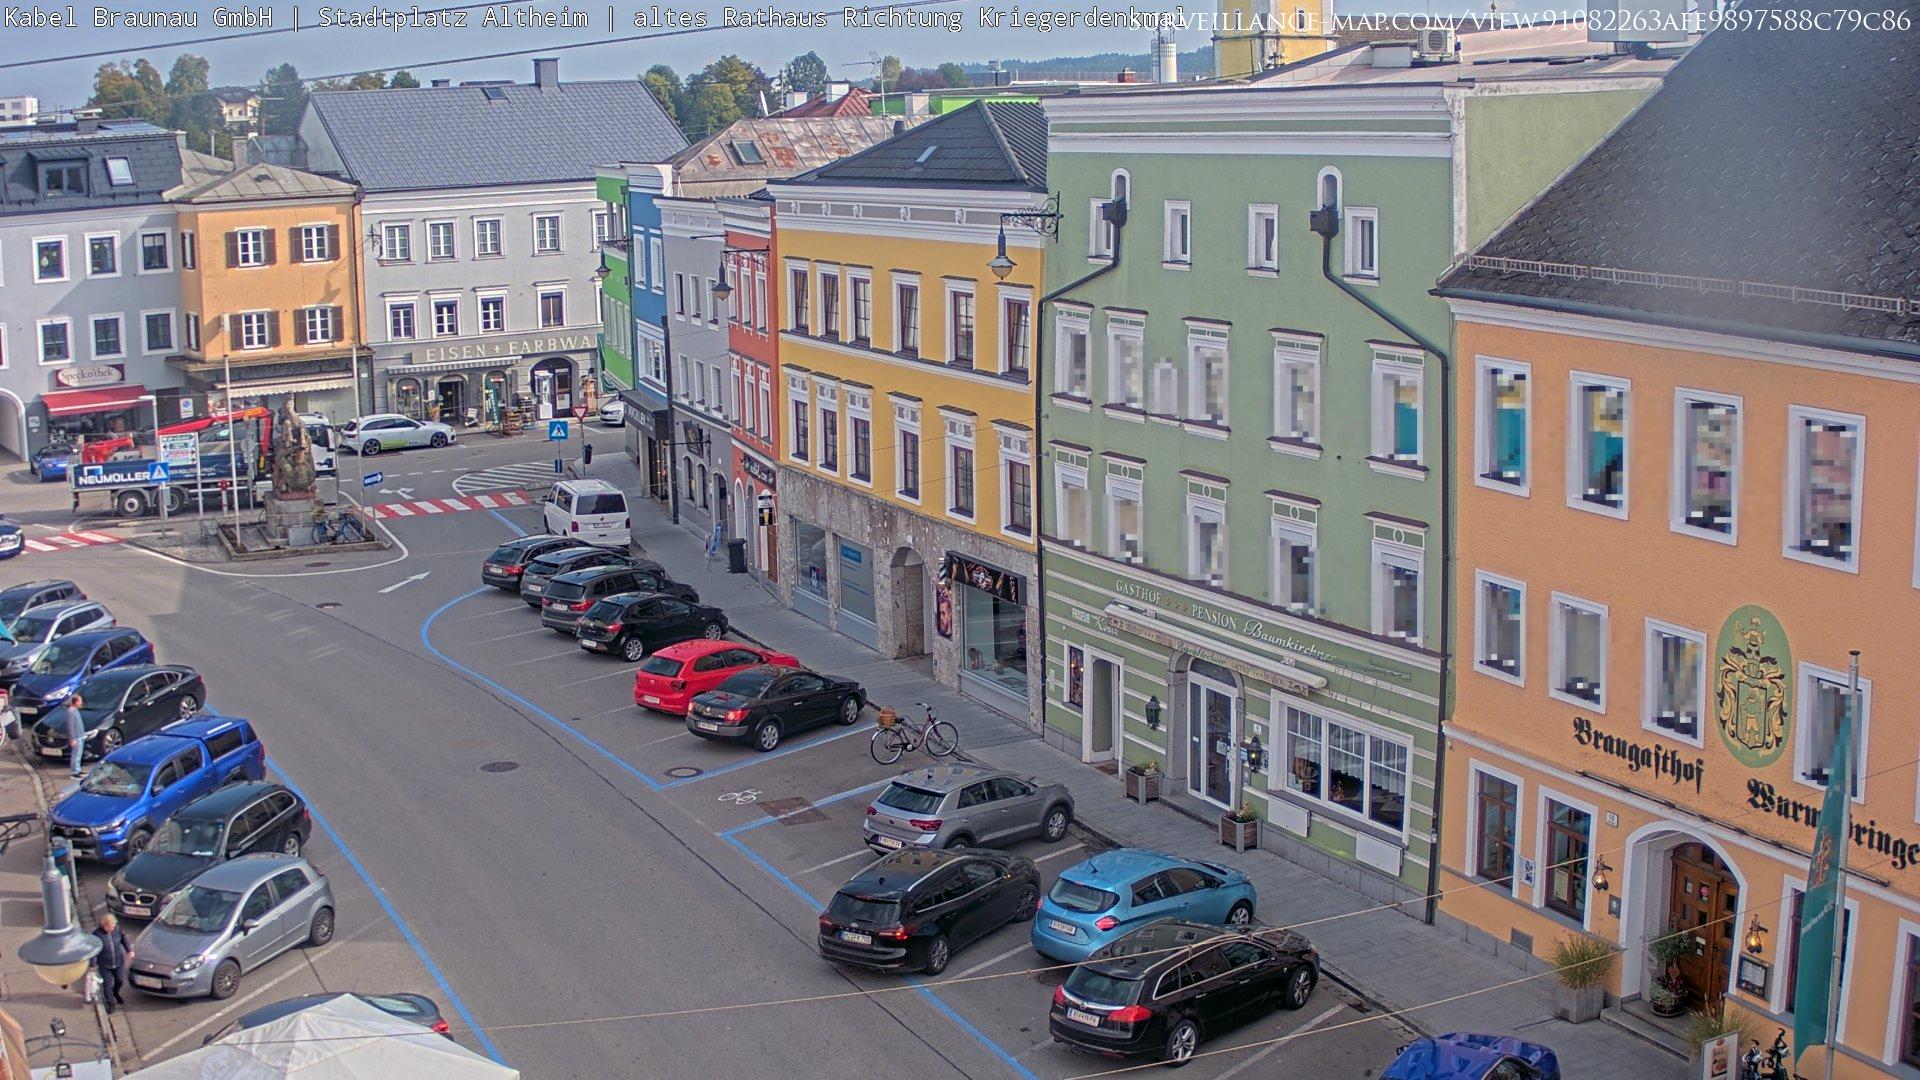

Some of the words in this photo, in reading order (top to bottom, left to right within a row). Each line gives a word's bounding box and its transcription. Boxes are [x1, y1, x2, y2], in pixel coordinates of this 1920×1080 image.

[426, 344, 486, 362] EISEN
[508, 335, 598, 355] FARBWA
[1115, 579, 1162, 604] GASTHOF
[1192, 604, 1238, 631] PENSION
[1243, 619, 1337, 662] Baumkirchner
